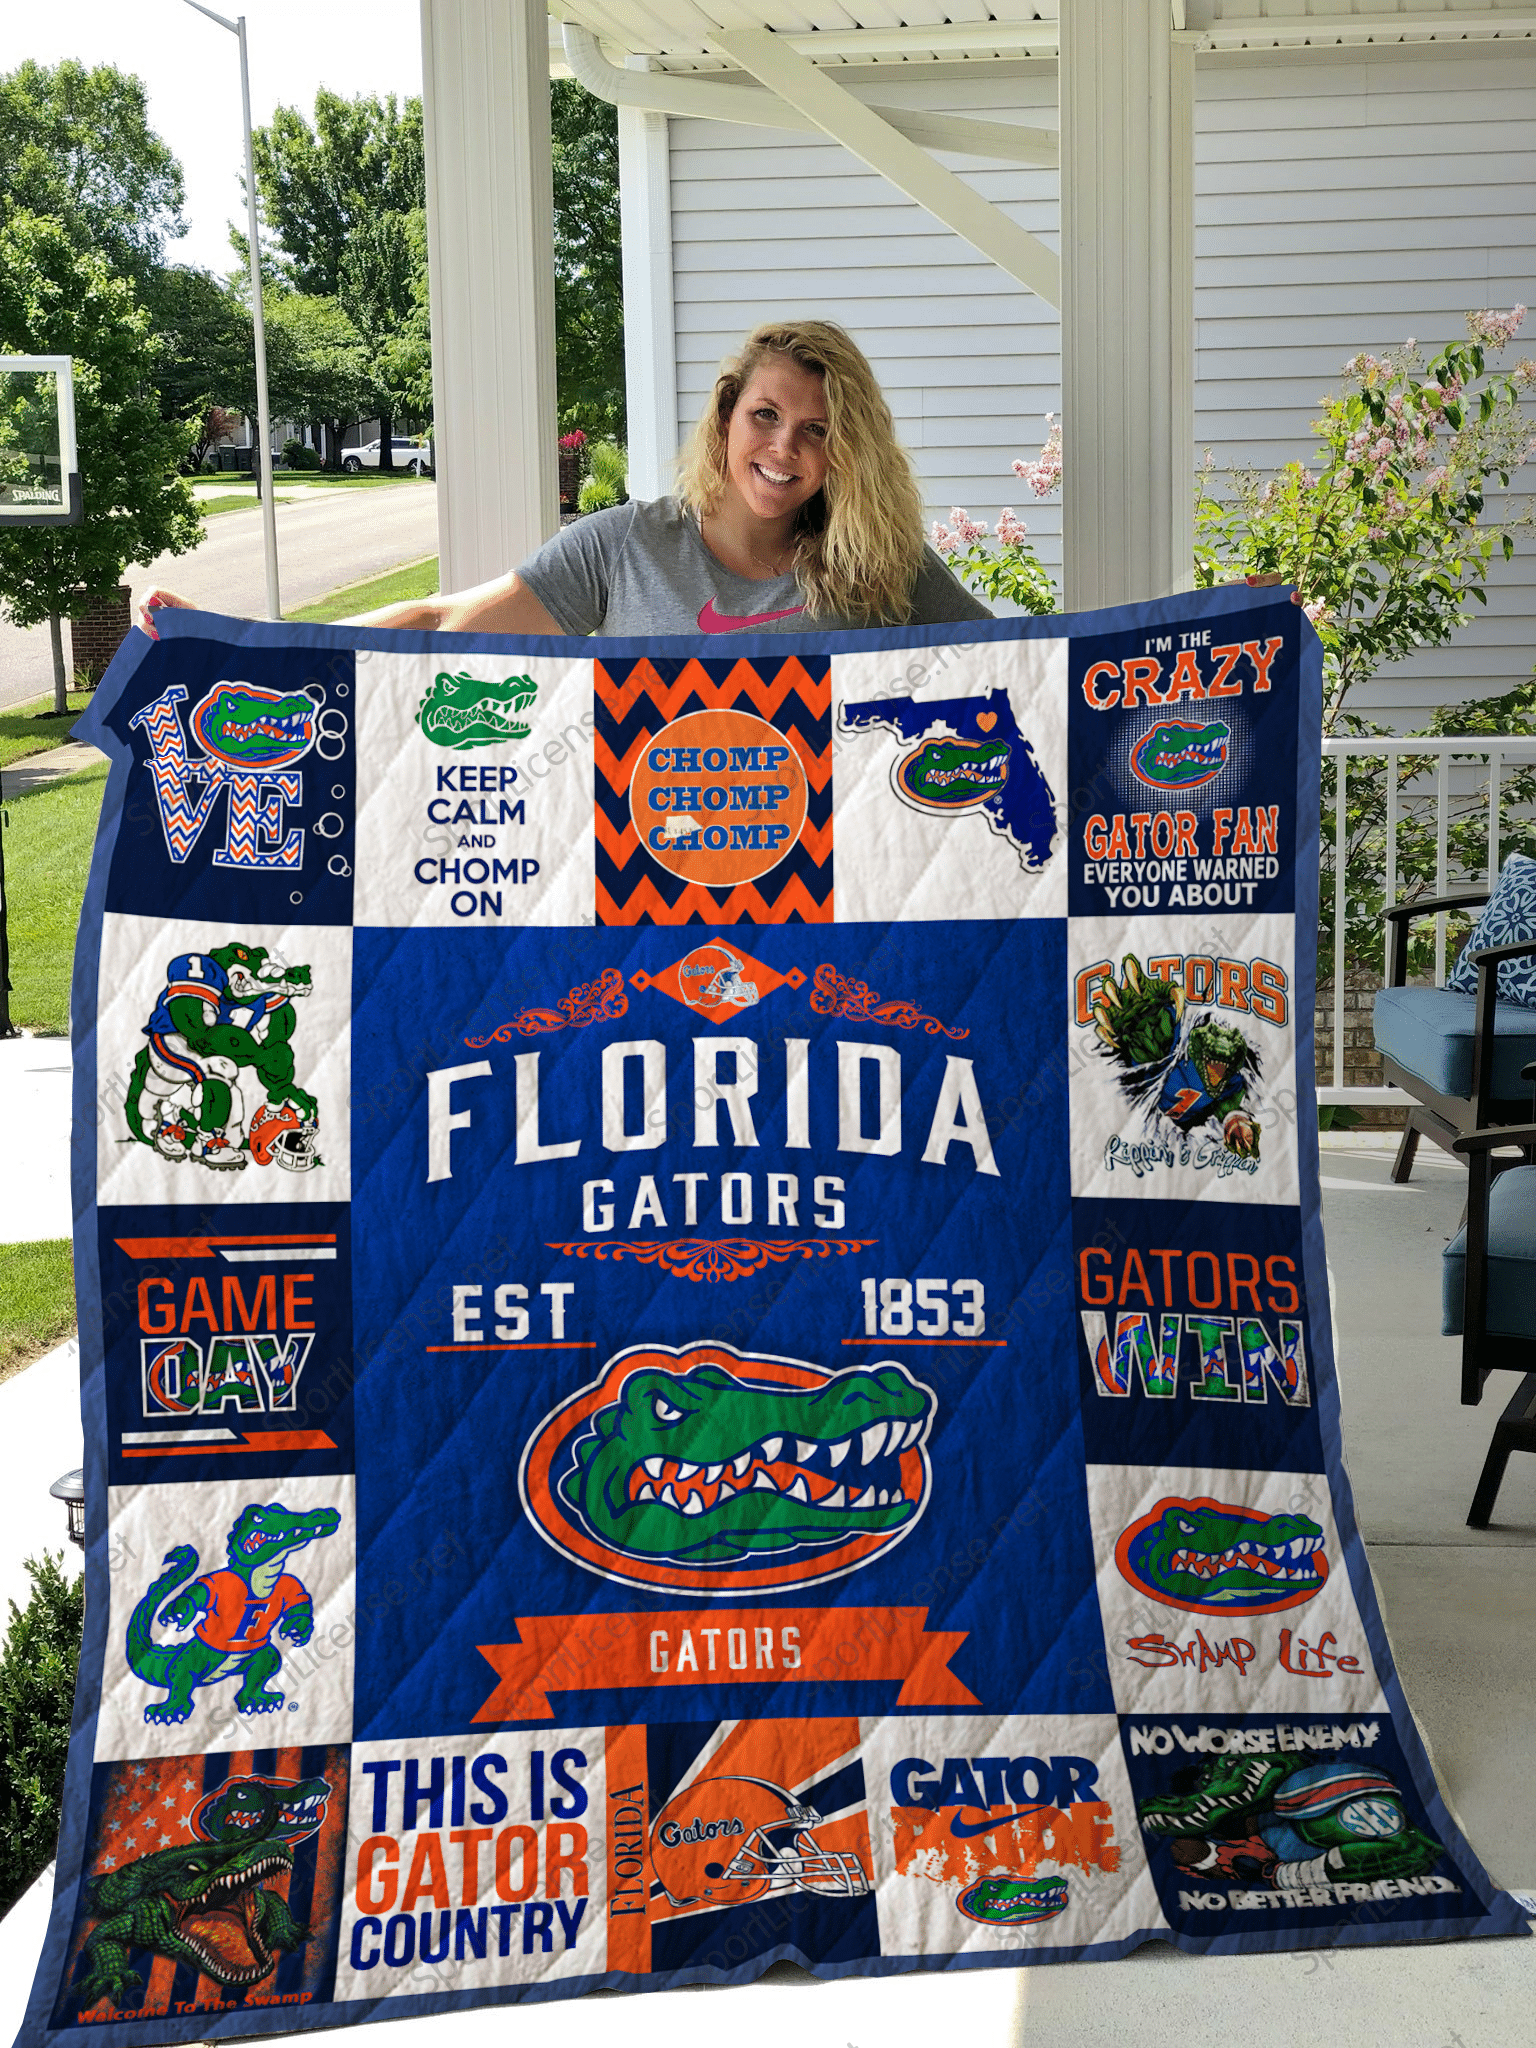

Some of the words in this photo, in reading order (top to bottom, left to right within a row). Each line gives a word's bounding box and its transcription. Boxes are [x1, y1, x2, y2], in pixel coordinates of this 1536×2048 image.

[12, 488, 61, 502] SPALDING
[1145, 635, 1172, 654] I'M
[1179, 629, 1211, 649] THE
[1082, 635, 1284, 711] CRAZY
[436, 766, 518, 792] KEEP
[648, 746, 790, 773] CHOMP
[427, 798, 525, 825] CALM
[648, 785, 790, 812] CHOMP
[457, 834, 496, 848] AND
[648, 824, 791, 851] CHOMP
[1083, 809, 1199, 861] GATOR
[1213, 805, 1279, 856] FAN
[414, 858, 540, 884] CHOMP
[1083, 859, 1188, 884] EVERYONE
[1193, 856, 1279, 881] WARNED
[450, 891, 502, 917] ON
[1104, 885, 1161, 908] YOU
[1168, 882, 1259, 907] ABOUT
[187, 955, 205, 980] 1
[1074, 954, 1289, 1028] GTORS
[250, 1109, 293, 1131] Gators
[426, 1036, 1001, 1183] FLORIDA
[582, 1172, 846, 1233] GATORS
[1080, 1247, 1299, 1313] GATORS
[138, 1274, 316, 1334] GAME
[452, 1282, 575, 1342] EST
[861, 1277, 986, 1337] 1853
[140, 1333, 316, 1417] DAY
[1080, 1310, 1311, 1407] WIN
[228, 1602, 272, 1643] F
[650, 1626, 801, 1673] GATORS
[1278, 1628, 1365, 1677] Life
[1130, 1724, 1175, 1756] NO
[1171, 1725, 1276, 1754] WORSE
[1276, 1721, 1381, 1751] ENEMY
[362, 1752, 508, 1833] THIS
[530, 1748, 590, 1822] IS
[890, 1756, 1103, 1812] GATOR
[659, 1817, 745, 1849] Gators
[1342, 1799, 1401, 1837] SEC
[609, 1781, 646, 1918] FLORIDA
[890, 1801, 1121, 1887] PRIDE
[355, 1822, 590, 1916] GATOR
[1178, 1889, 1228, 1912] NO
[1228, 1884, 1338, 1911] BETTER
[350, 1897, 589, 1971] COUNTRY
[77, 2005, 169, 2025] Welcome
[174, 2001, 197, 2015] To
[200, 1998, 238, 2012] The
[242, 1991, 314, 2009] Swamp
